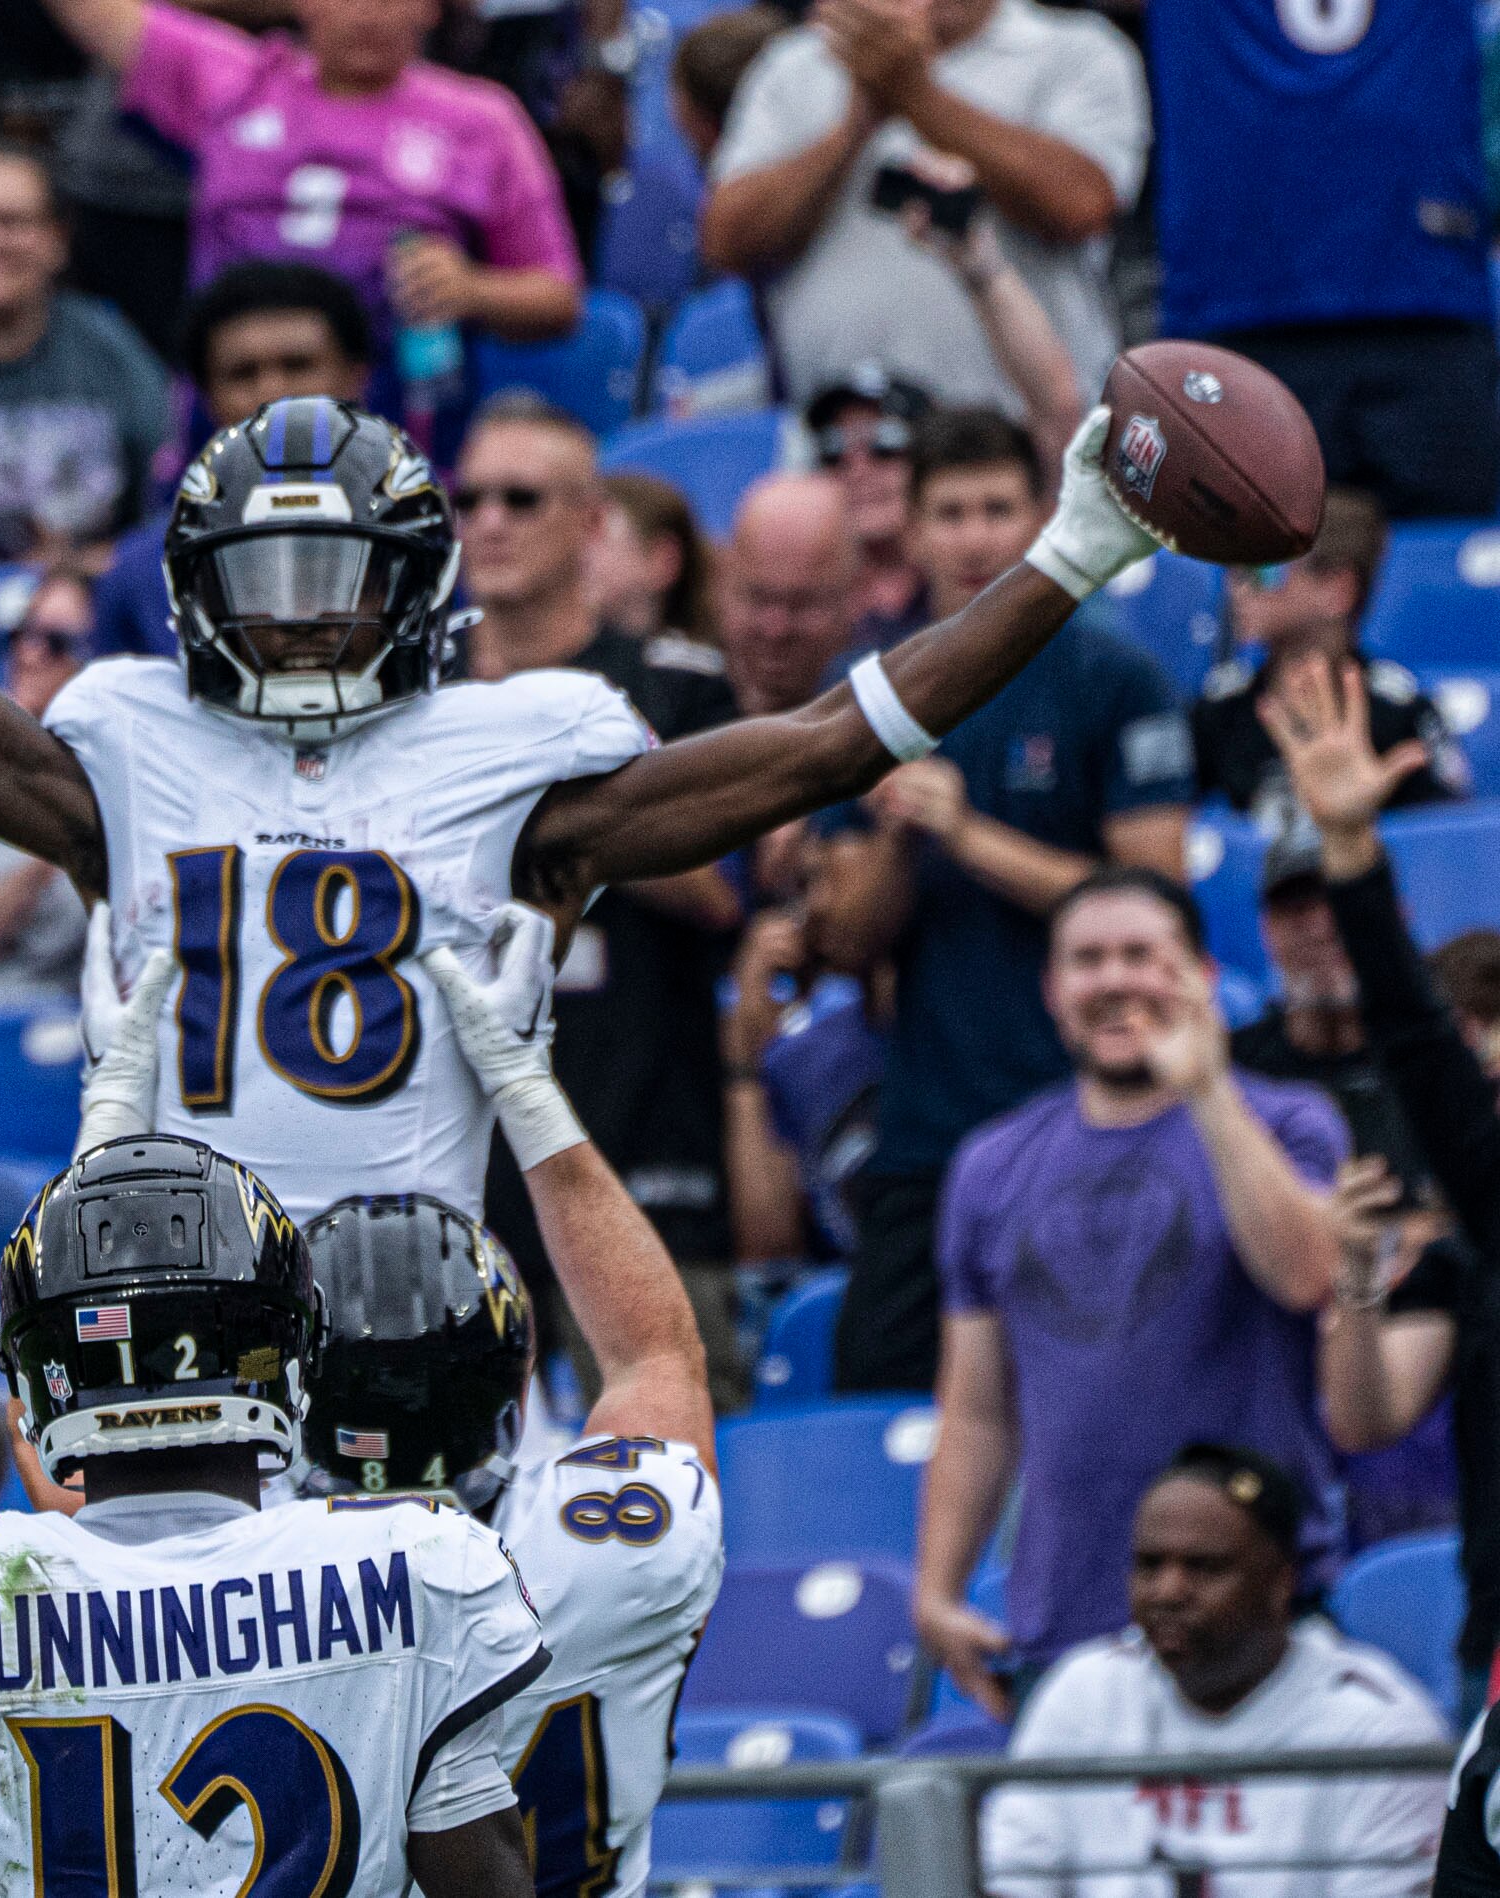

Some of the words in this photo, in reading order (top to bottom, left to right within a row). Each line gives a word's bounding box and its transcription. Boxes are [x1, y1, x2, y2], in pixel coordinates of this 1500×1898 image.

[255, 832, 346, 850] RAVENS
[166, 844, 421, 1119] 18
[49, 1378, 69, 1397] NFL
[93, 1402, 222, 1432] RAVENS
[3, 1702, 362, 1898] 12
